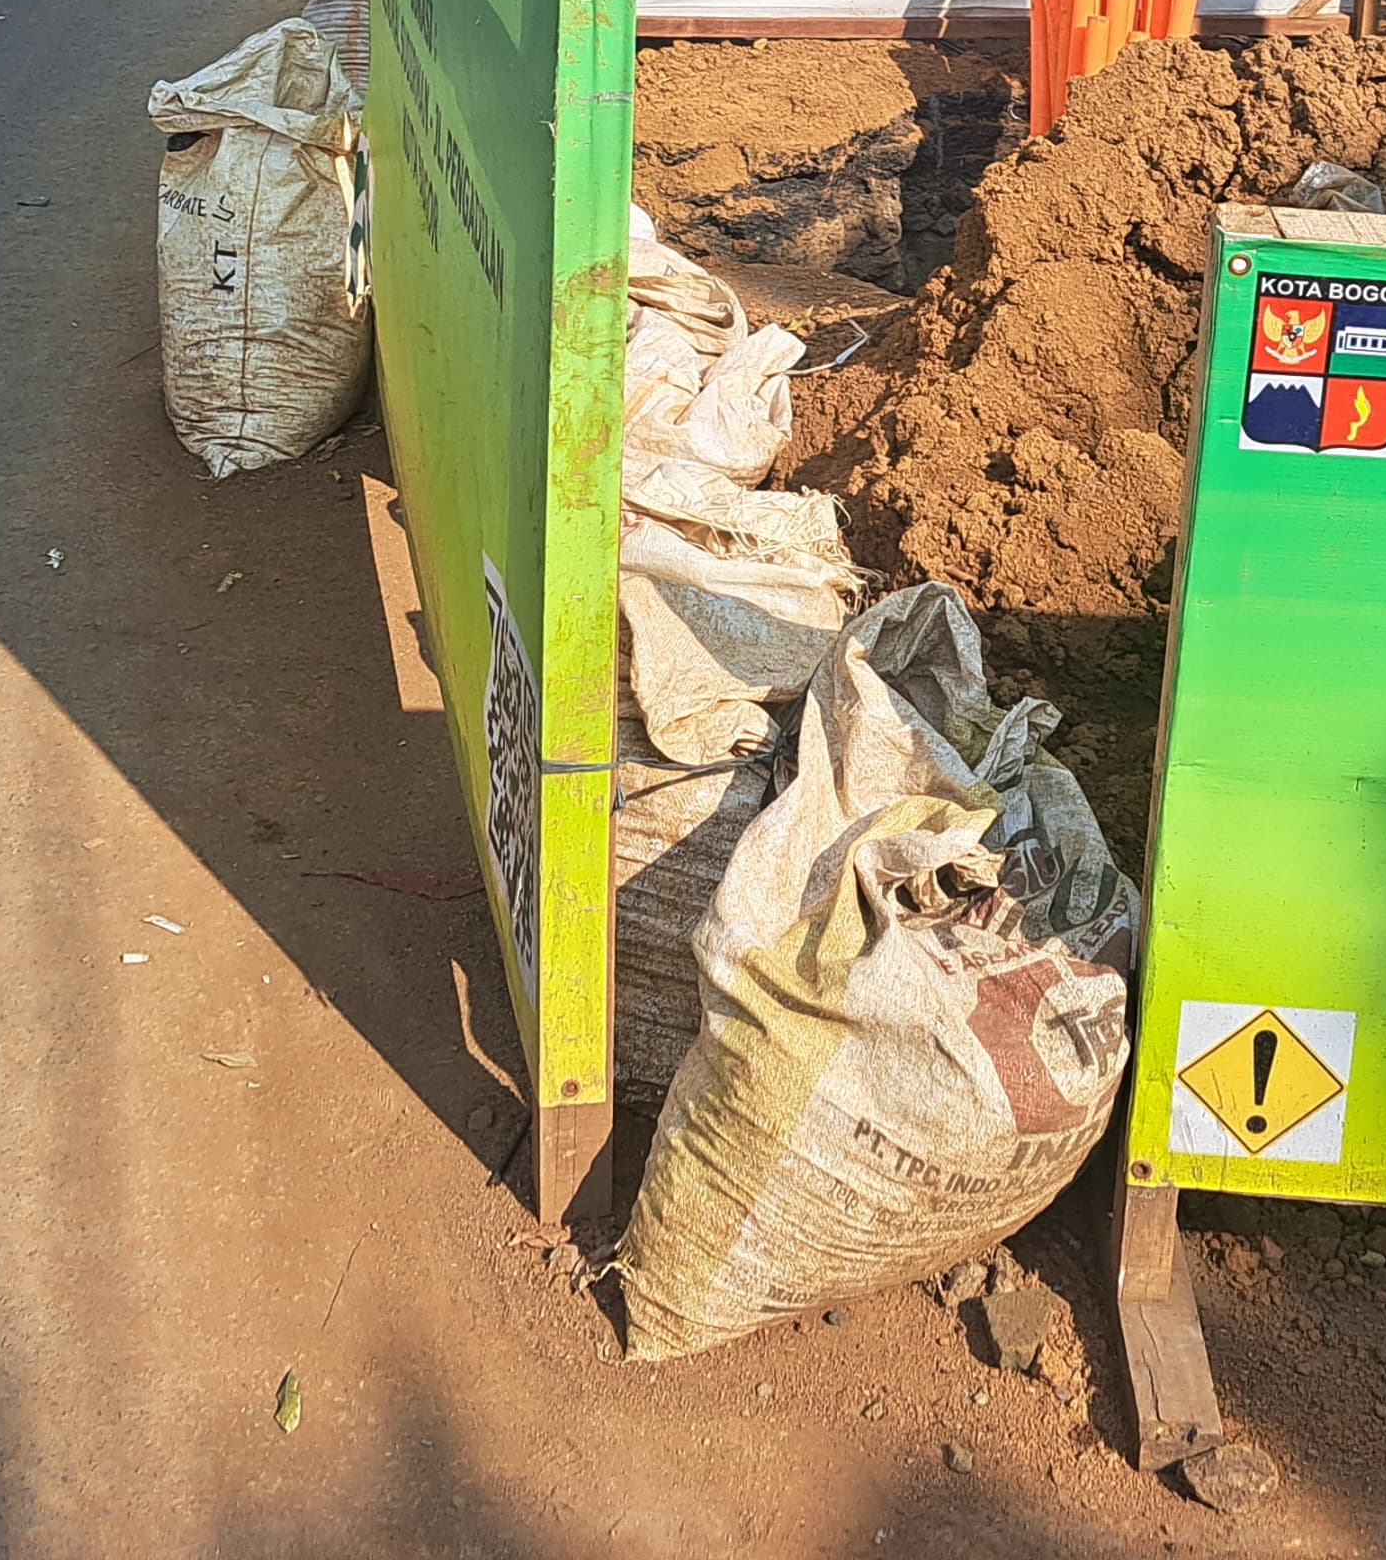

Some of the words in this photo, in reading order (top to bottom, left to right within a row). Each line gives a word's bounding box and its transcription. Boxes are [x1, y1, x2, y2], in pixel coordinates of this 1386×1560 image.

[1261, 276, 1323, 299] KOTA
[894, 1146, 941, 1188] TPC
[946, 1172, 1001, 1195] INDO
